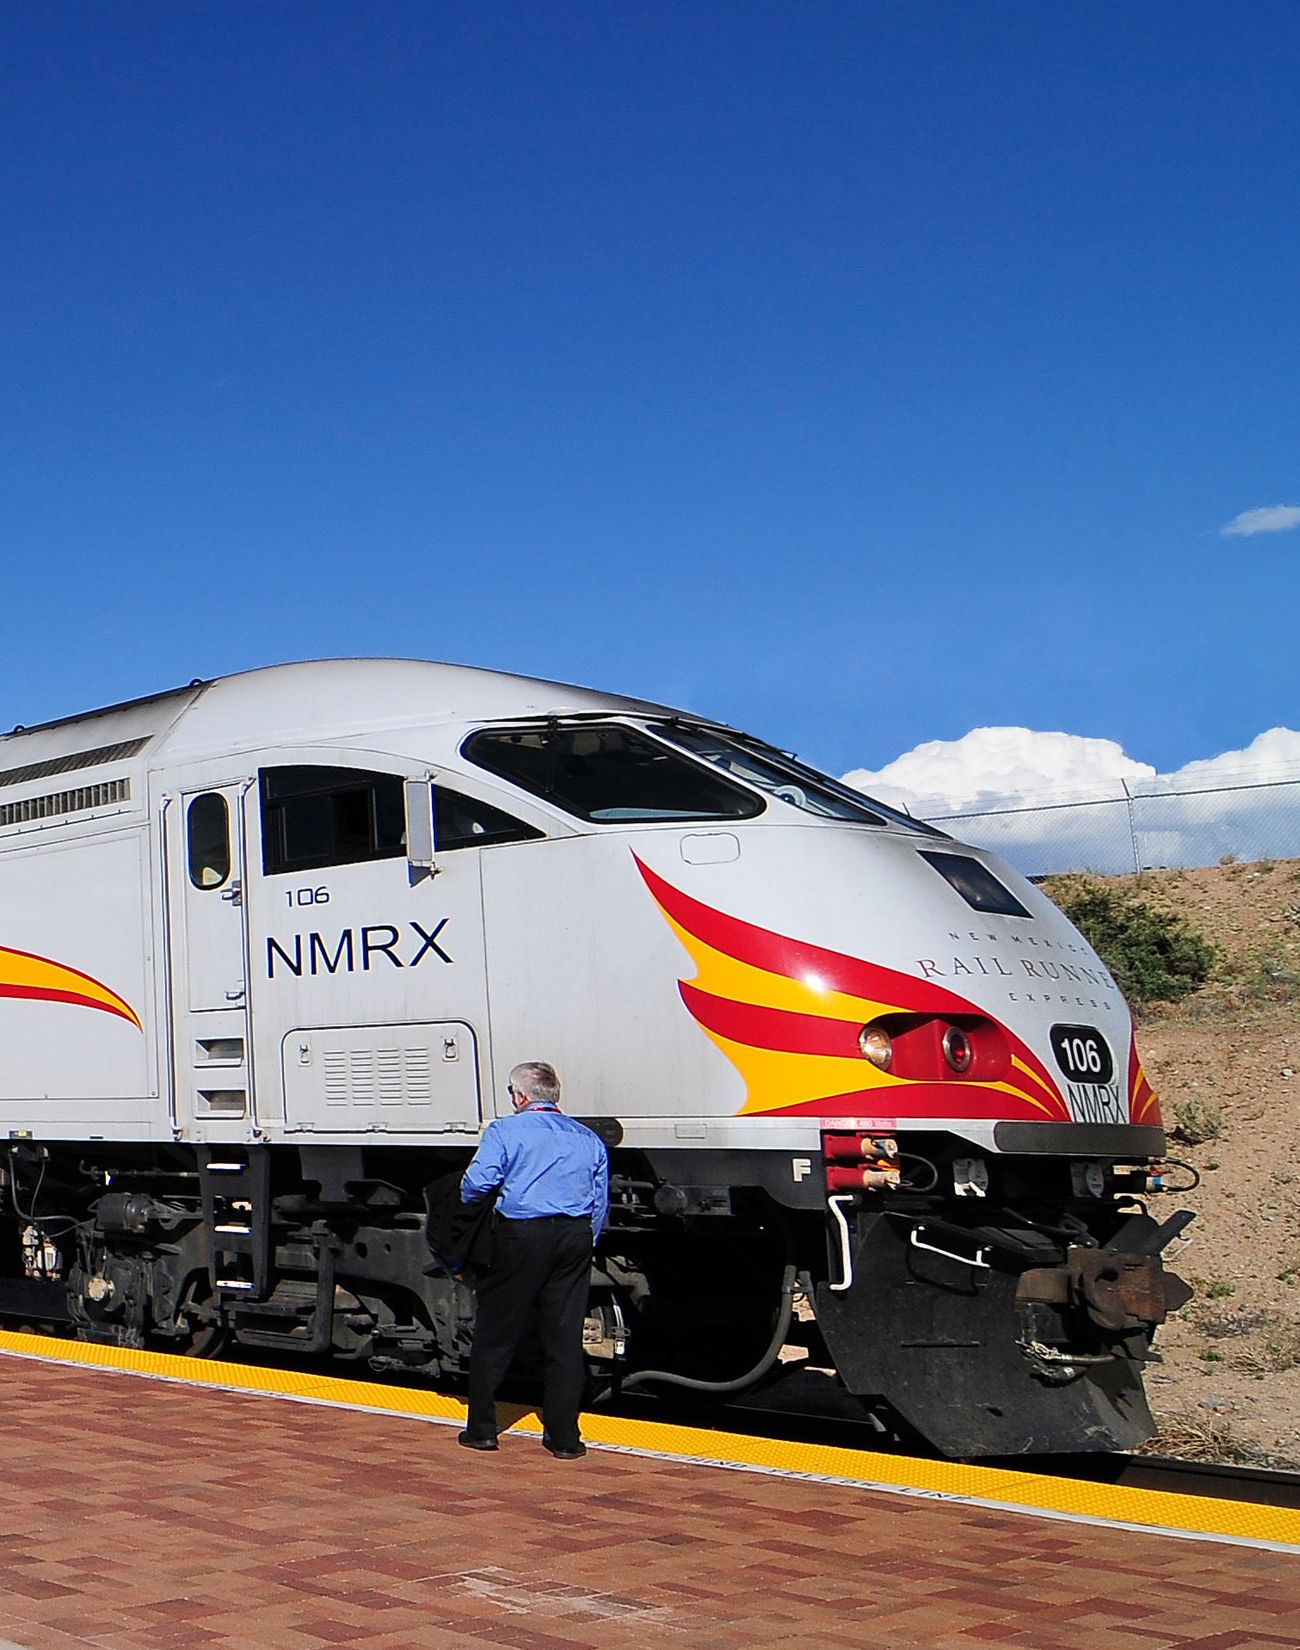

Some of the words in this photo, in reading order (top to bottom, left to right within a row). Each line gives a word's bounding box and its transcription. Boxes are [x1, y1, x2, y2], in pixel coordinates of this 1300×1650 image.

[285, 886, 330, 907] 106
[266, 918, 454, 979] NMRX
[949, 932, 998, 942] NEW
[916, 956, 1013, 978] RAIL
[1020, 959, 1115, 990] RUNNE
[1008, 992, 1111, 1010] EXPRESS
[1061, 1038, 1101, 1073] 106
[1067, 1084, 1127, 1124] NMRX
[792, 1158, 812, 1182] F
[652, 1452, 748, 1469] BHIND
